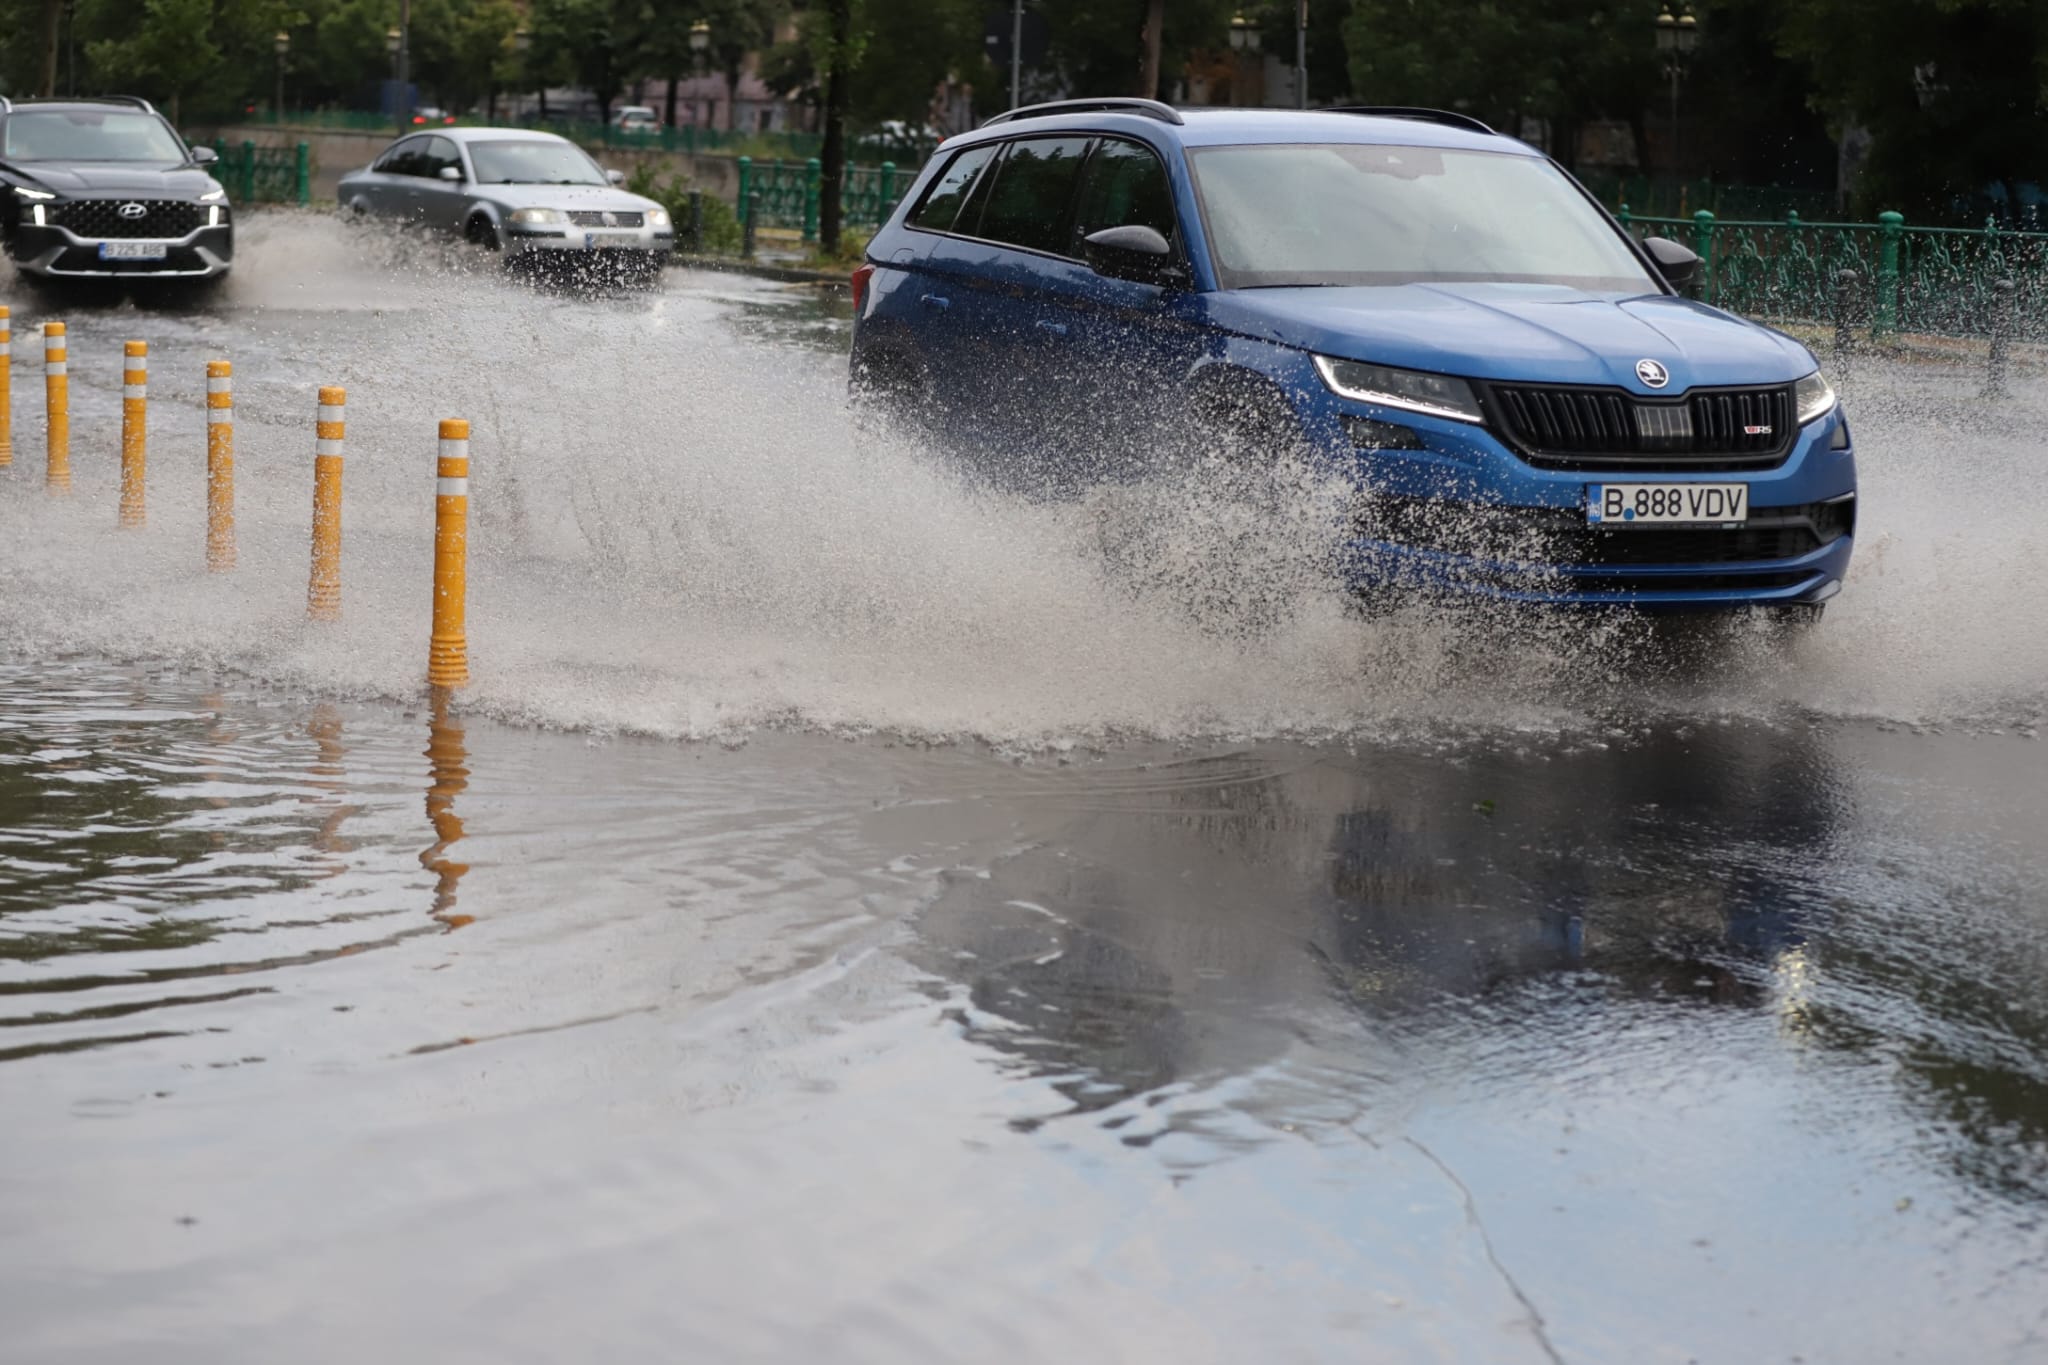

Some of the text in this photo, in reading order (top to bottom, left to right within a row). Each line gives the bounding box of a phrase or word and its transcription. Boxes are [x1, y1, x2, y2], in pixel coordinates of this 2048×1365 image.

[1605, 488, 1624, 518] B
[1634, 488, 1682, 518] 888
[1688, 488, 1743, 518] VDV
